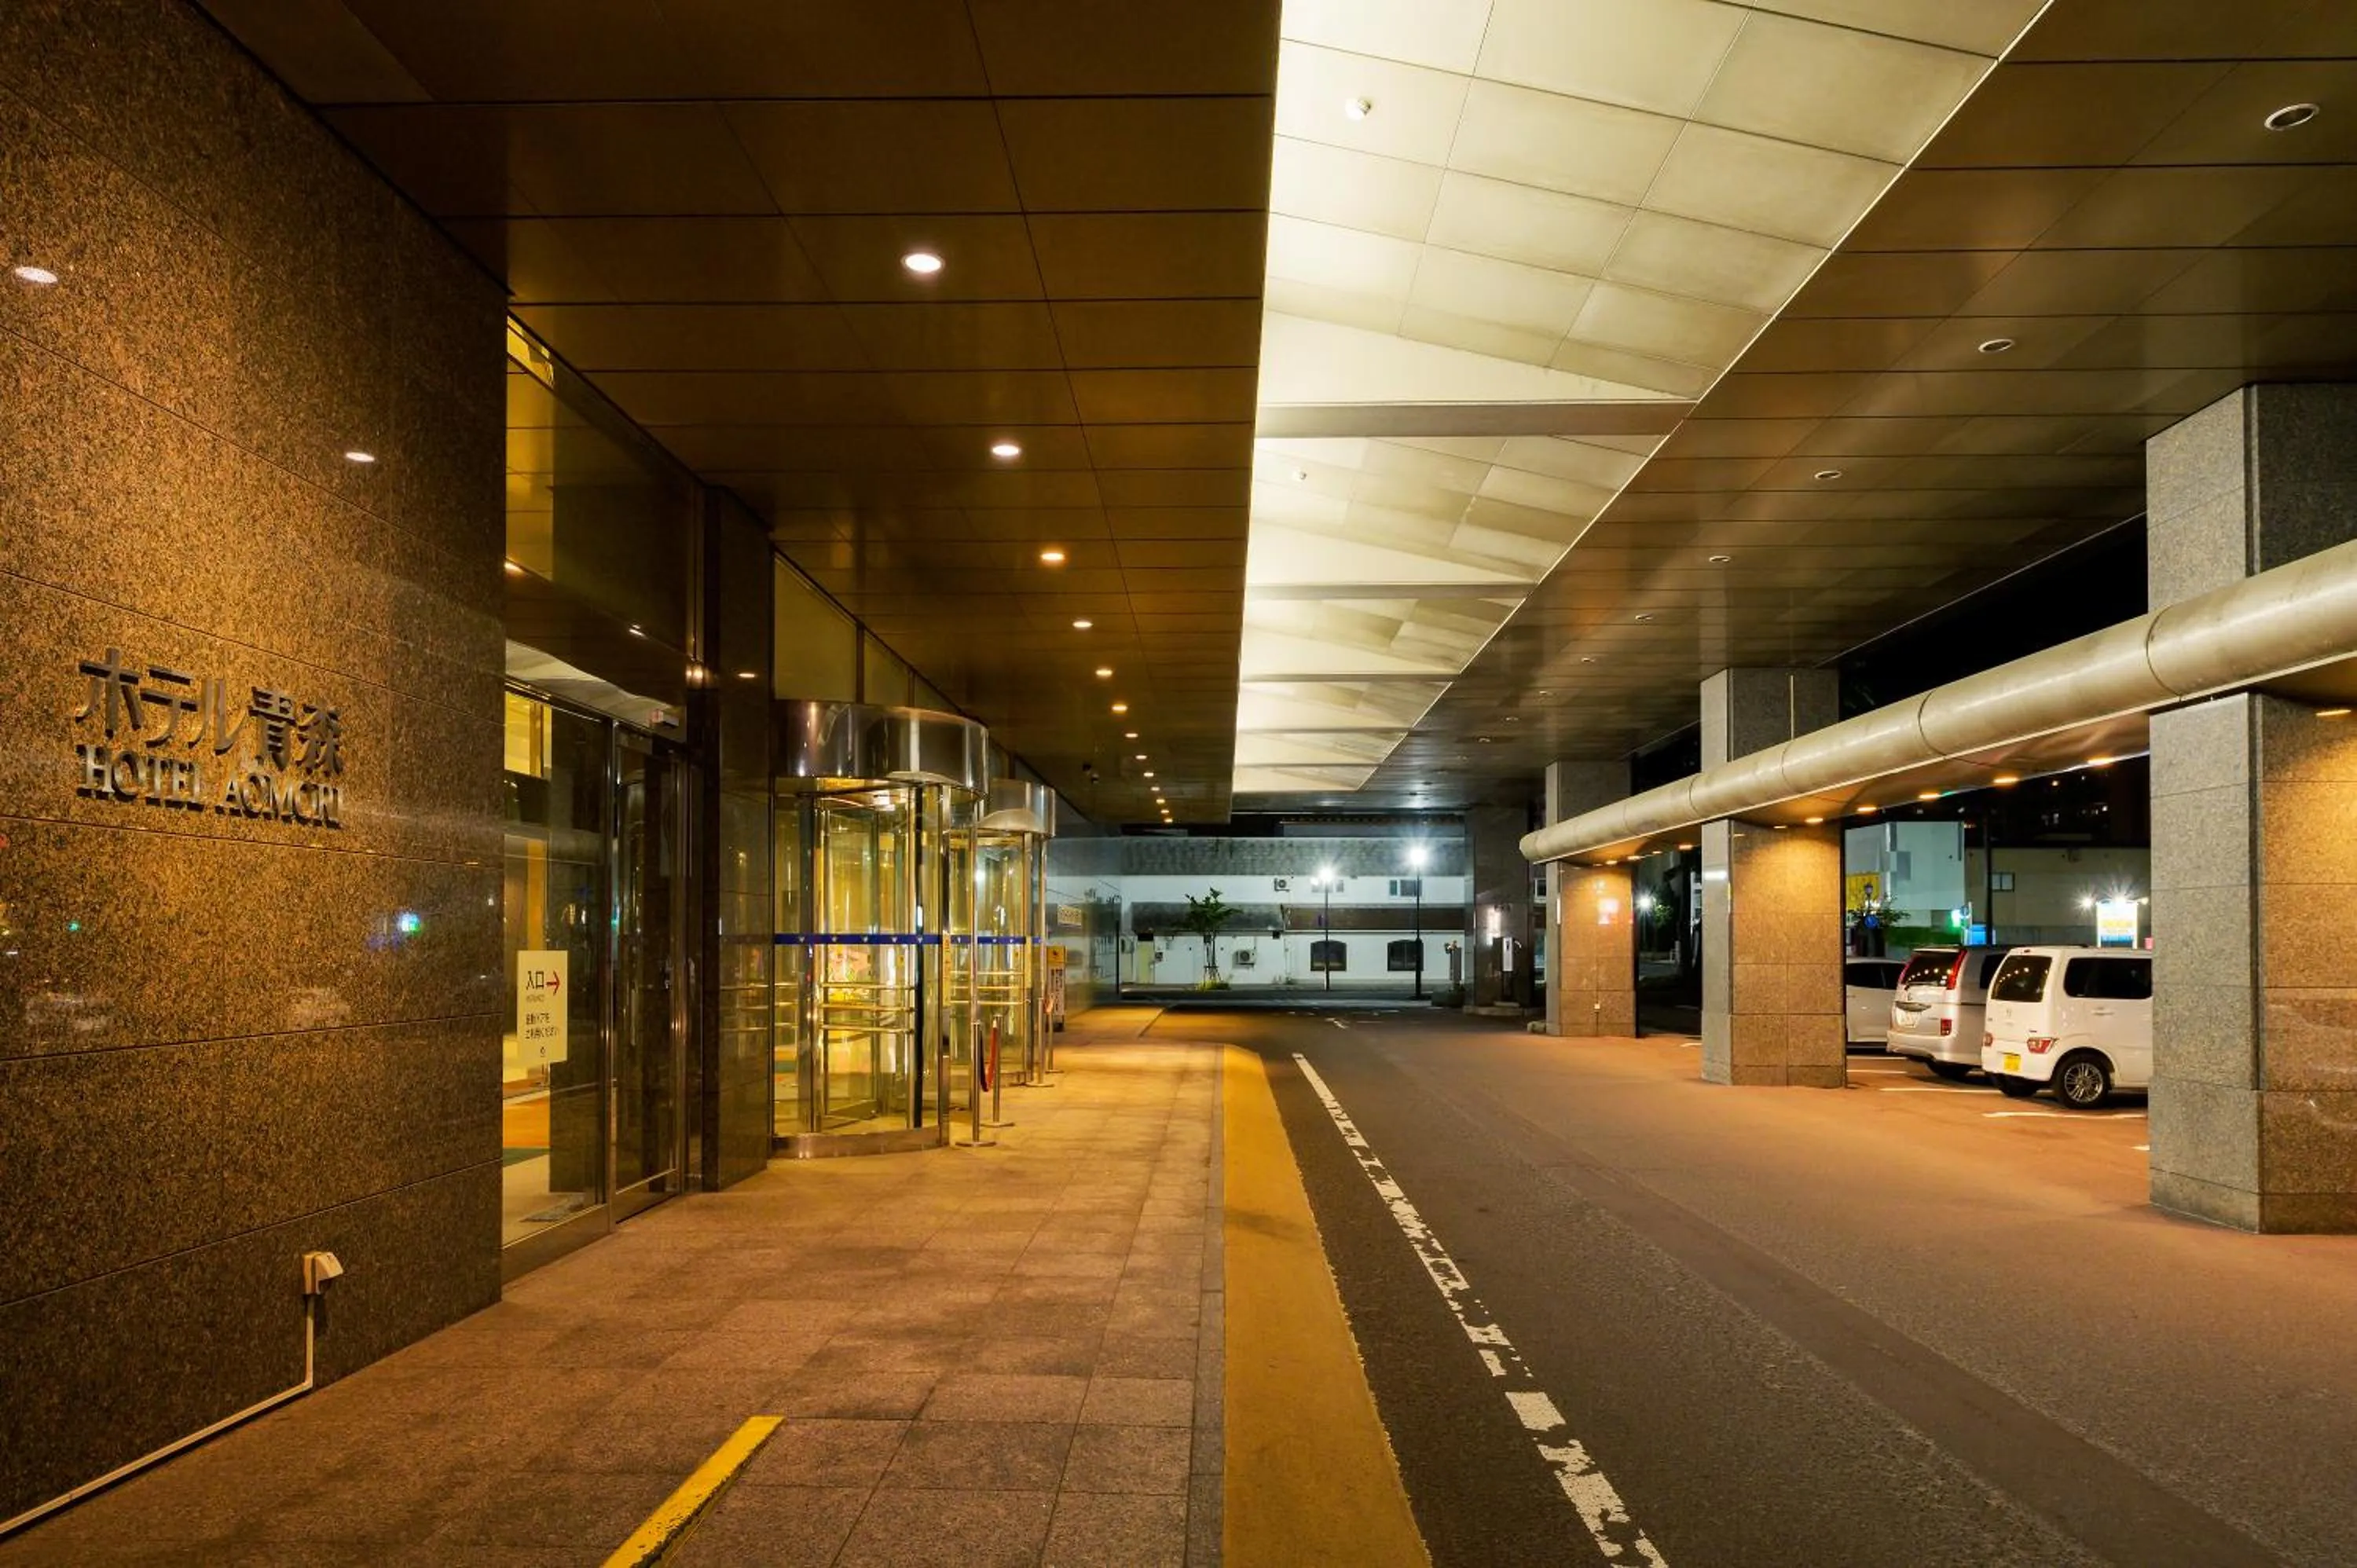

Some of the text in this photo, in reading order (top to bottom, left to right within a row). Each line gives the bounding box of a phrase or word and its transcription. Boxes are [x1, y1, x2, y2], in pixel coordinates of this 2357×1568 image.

[76, 647, 343, 775] ホテル青森
[76, 744, 342, 829] HOTEL AOMORI
[526, 970, 544, 990] 入口
